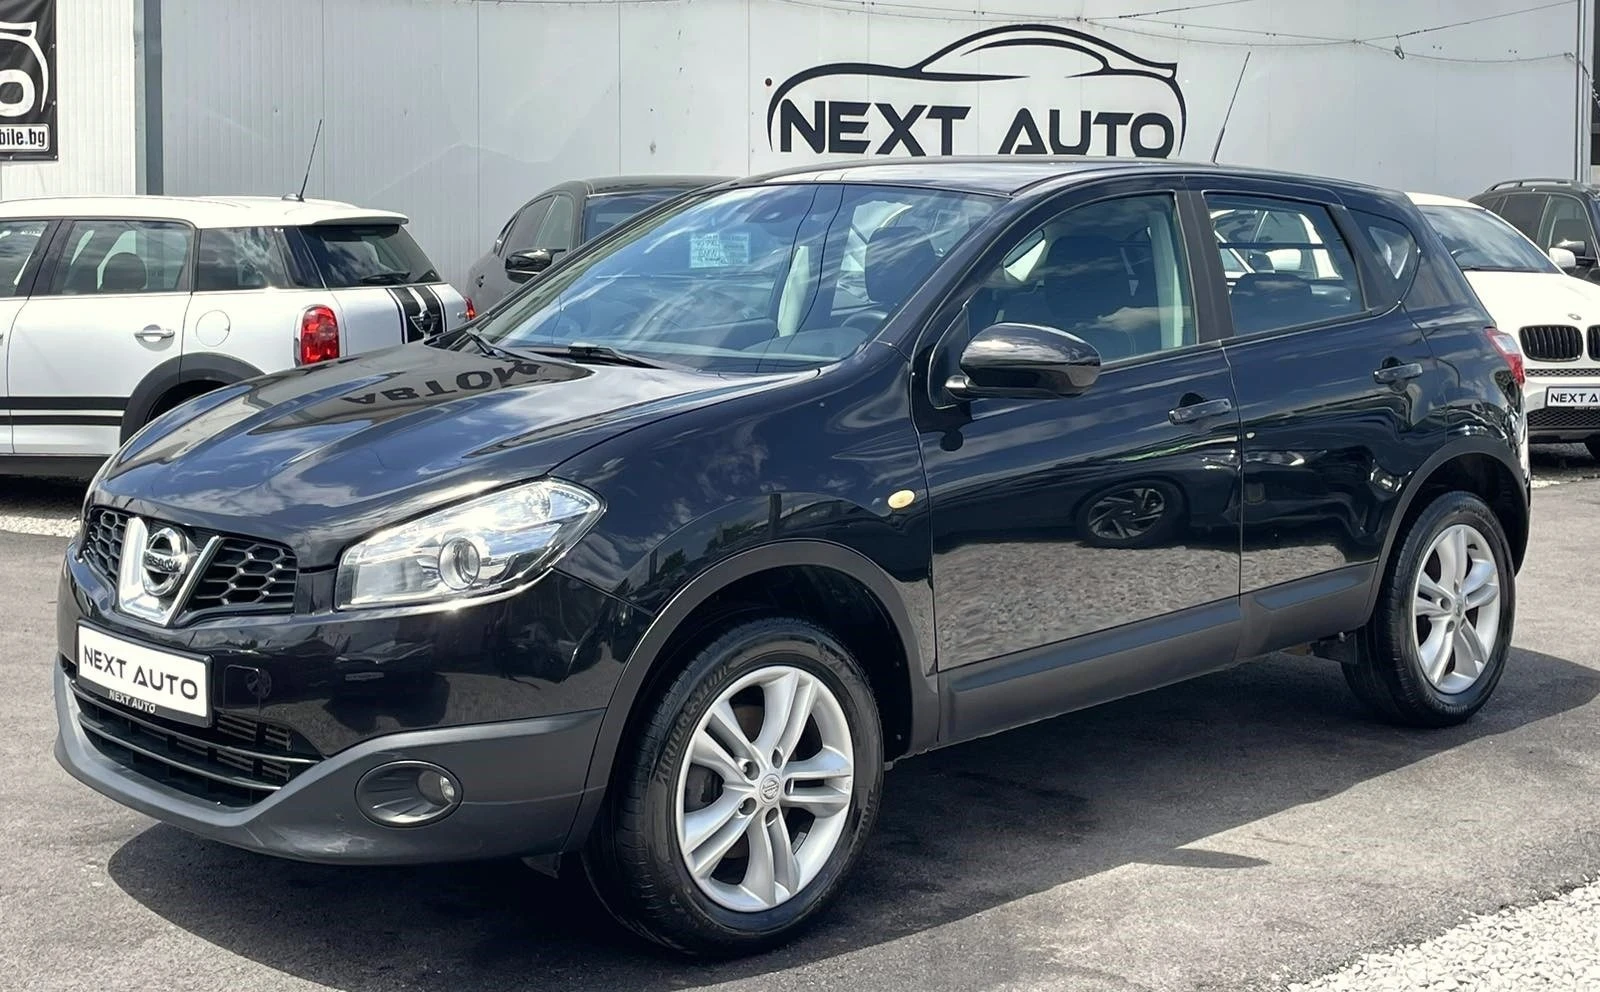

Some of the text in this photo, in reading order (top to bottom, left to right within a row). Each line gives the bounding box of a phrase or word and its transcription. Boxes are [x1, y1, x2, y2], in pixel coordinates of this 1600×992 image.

[781, 99, 1175, 158] NEXT AUTO
[1551, 393, 1600, 403] NEXT A
[84, 644, 198, 700] NEXT AUTO
[108, 690, 156, 714] NEXT AUTO
